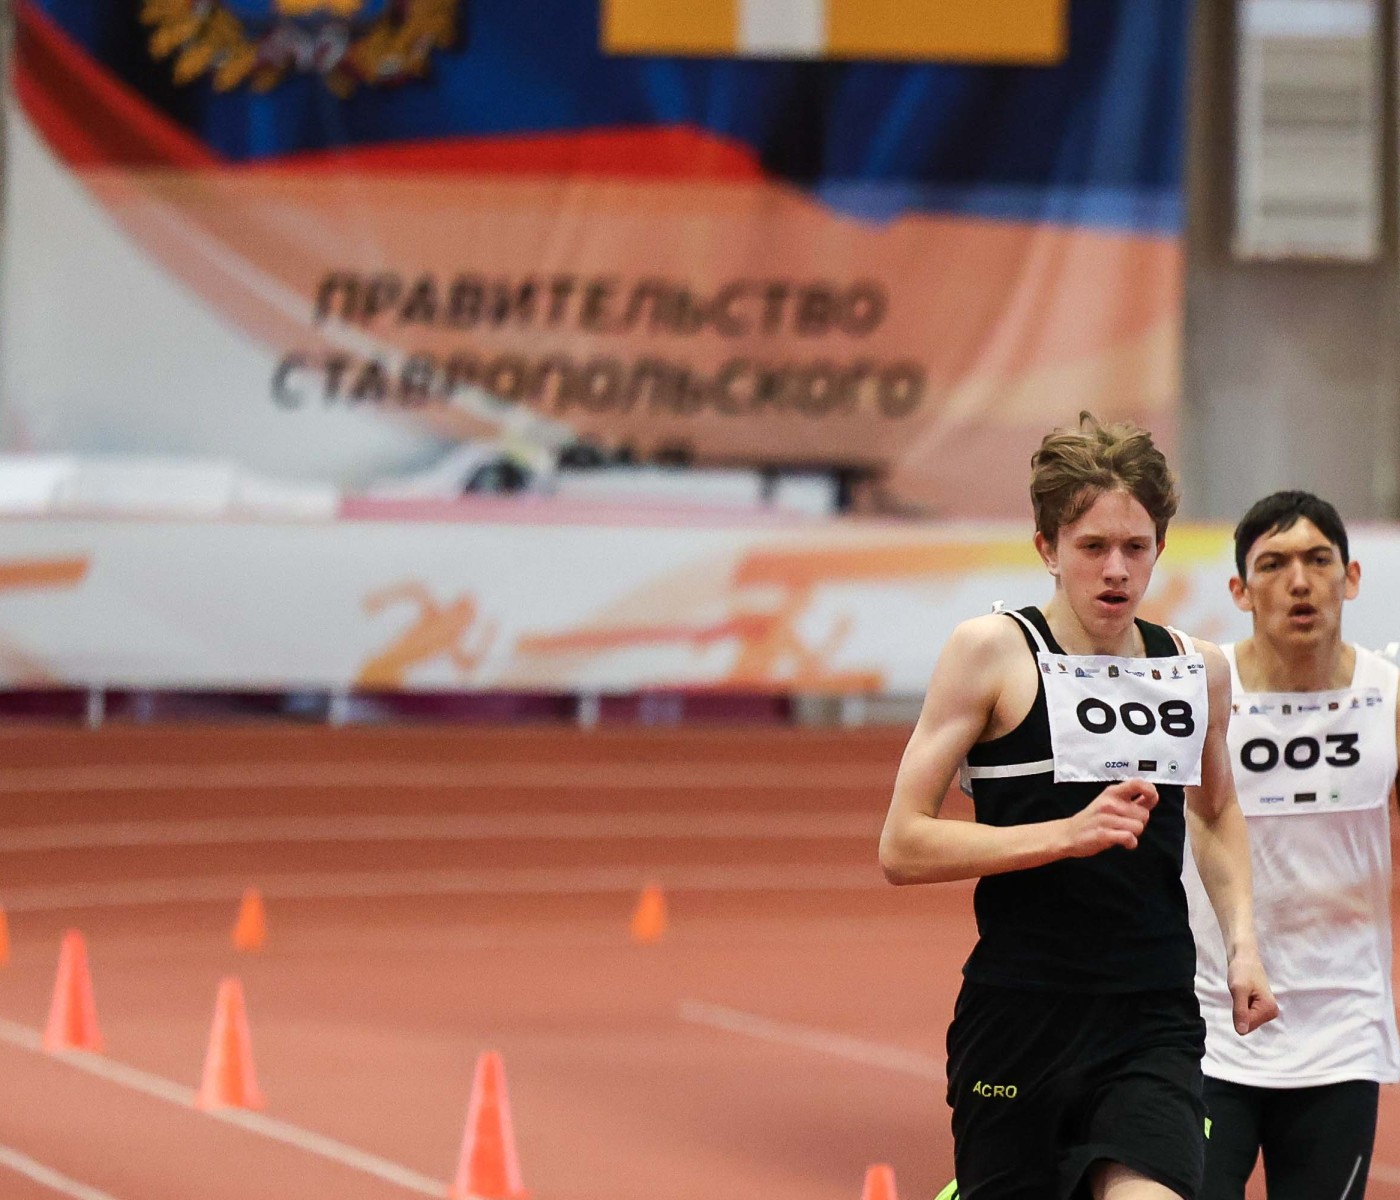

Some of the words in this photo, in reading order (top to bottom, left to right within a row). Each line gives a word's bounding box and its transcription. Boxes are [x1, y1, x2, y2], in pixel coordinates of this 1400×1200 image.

[313, 271, 888, 336] ПРАВИТЕЛЬСТВО
[270, 349, 927, 420] СТАВРОПОЛЬСКОГО
[1076, 697, 1195, 738] 008
[1105, 761, 1129, 769] OZON
[1240, 733, 1360, 773] 003
[972, 1080, 1018, 1099] ACRO
